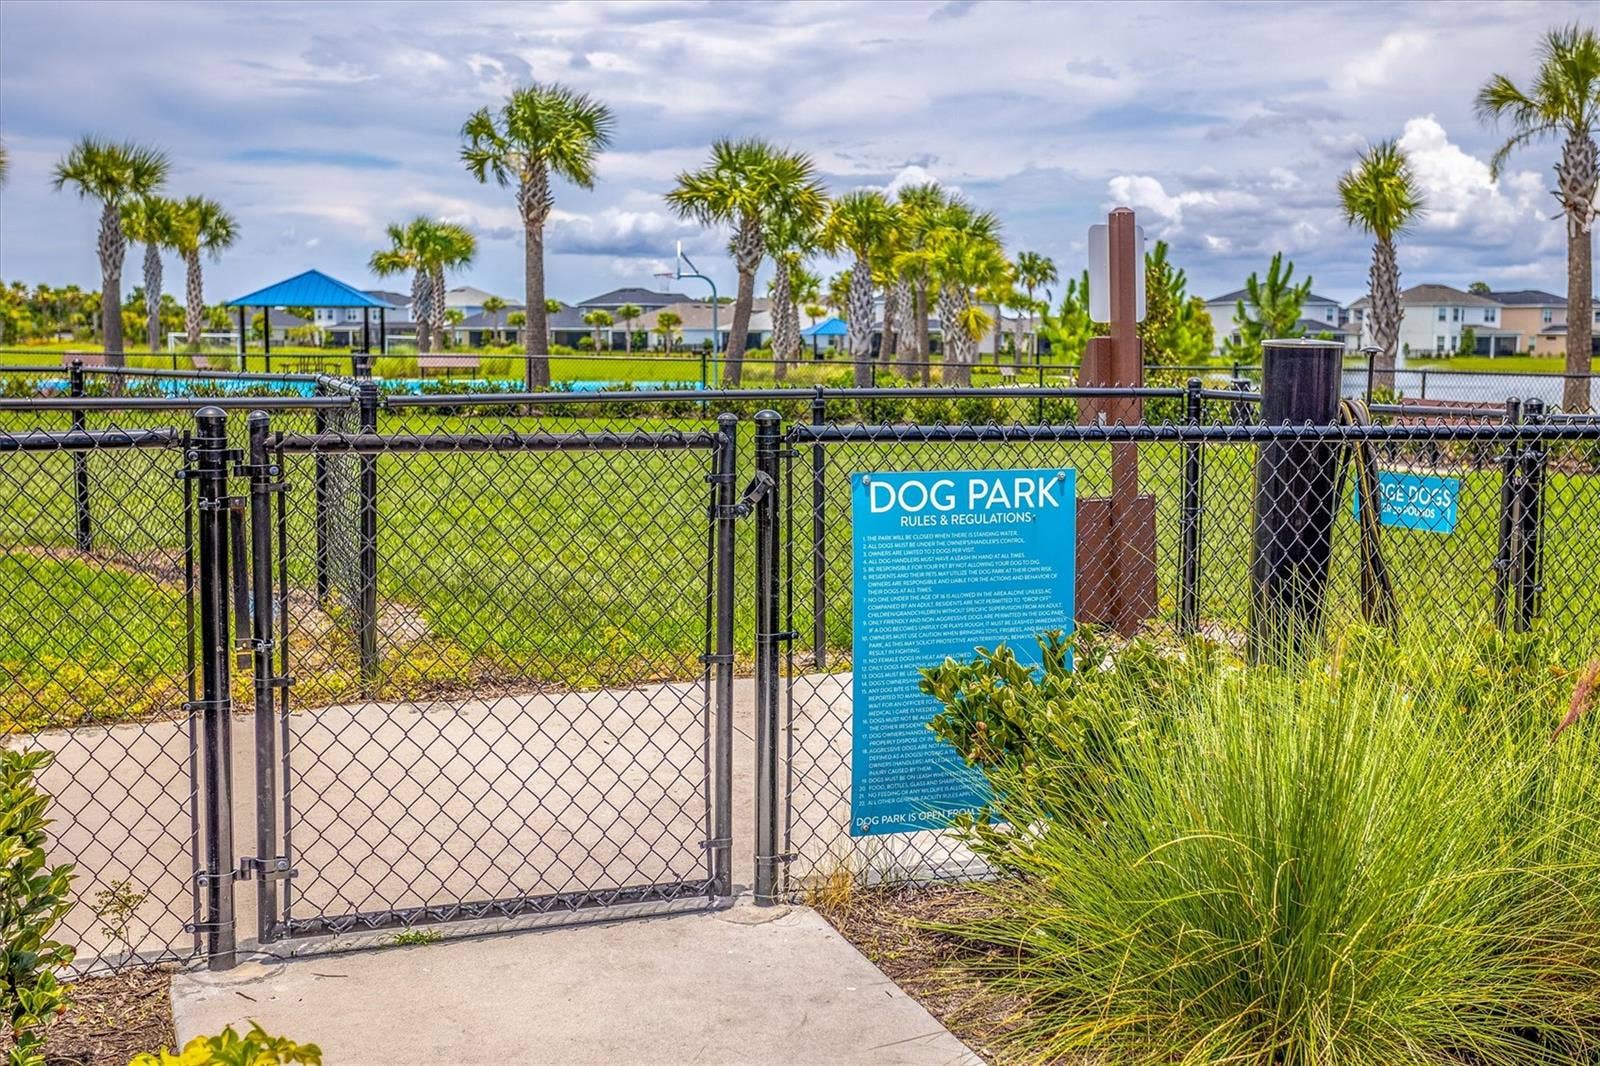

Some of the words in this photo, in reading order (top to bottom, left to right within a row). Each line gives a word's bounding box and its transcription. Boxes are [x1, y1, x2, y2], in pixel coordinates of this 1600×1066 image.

[870, 479, 956, 513] DOG
[968, 476, 1059, 510] PARK
[1408, 485, 1451, 508] DOGS
[901, 513, 937, 527] RULES
[940, 514, 949, 526] &
[951, 511, 1032, 526] REGULATIONS
[856, 816, 880, 827] DOG
[881, 813, 906, 824] PARK
[908, 813, 916, 822] IS
[918, 810, 946, 821] OPEN
